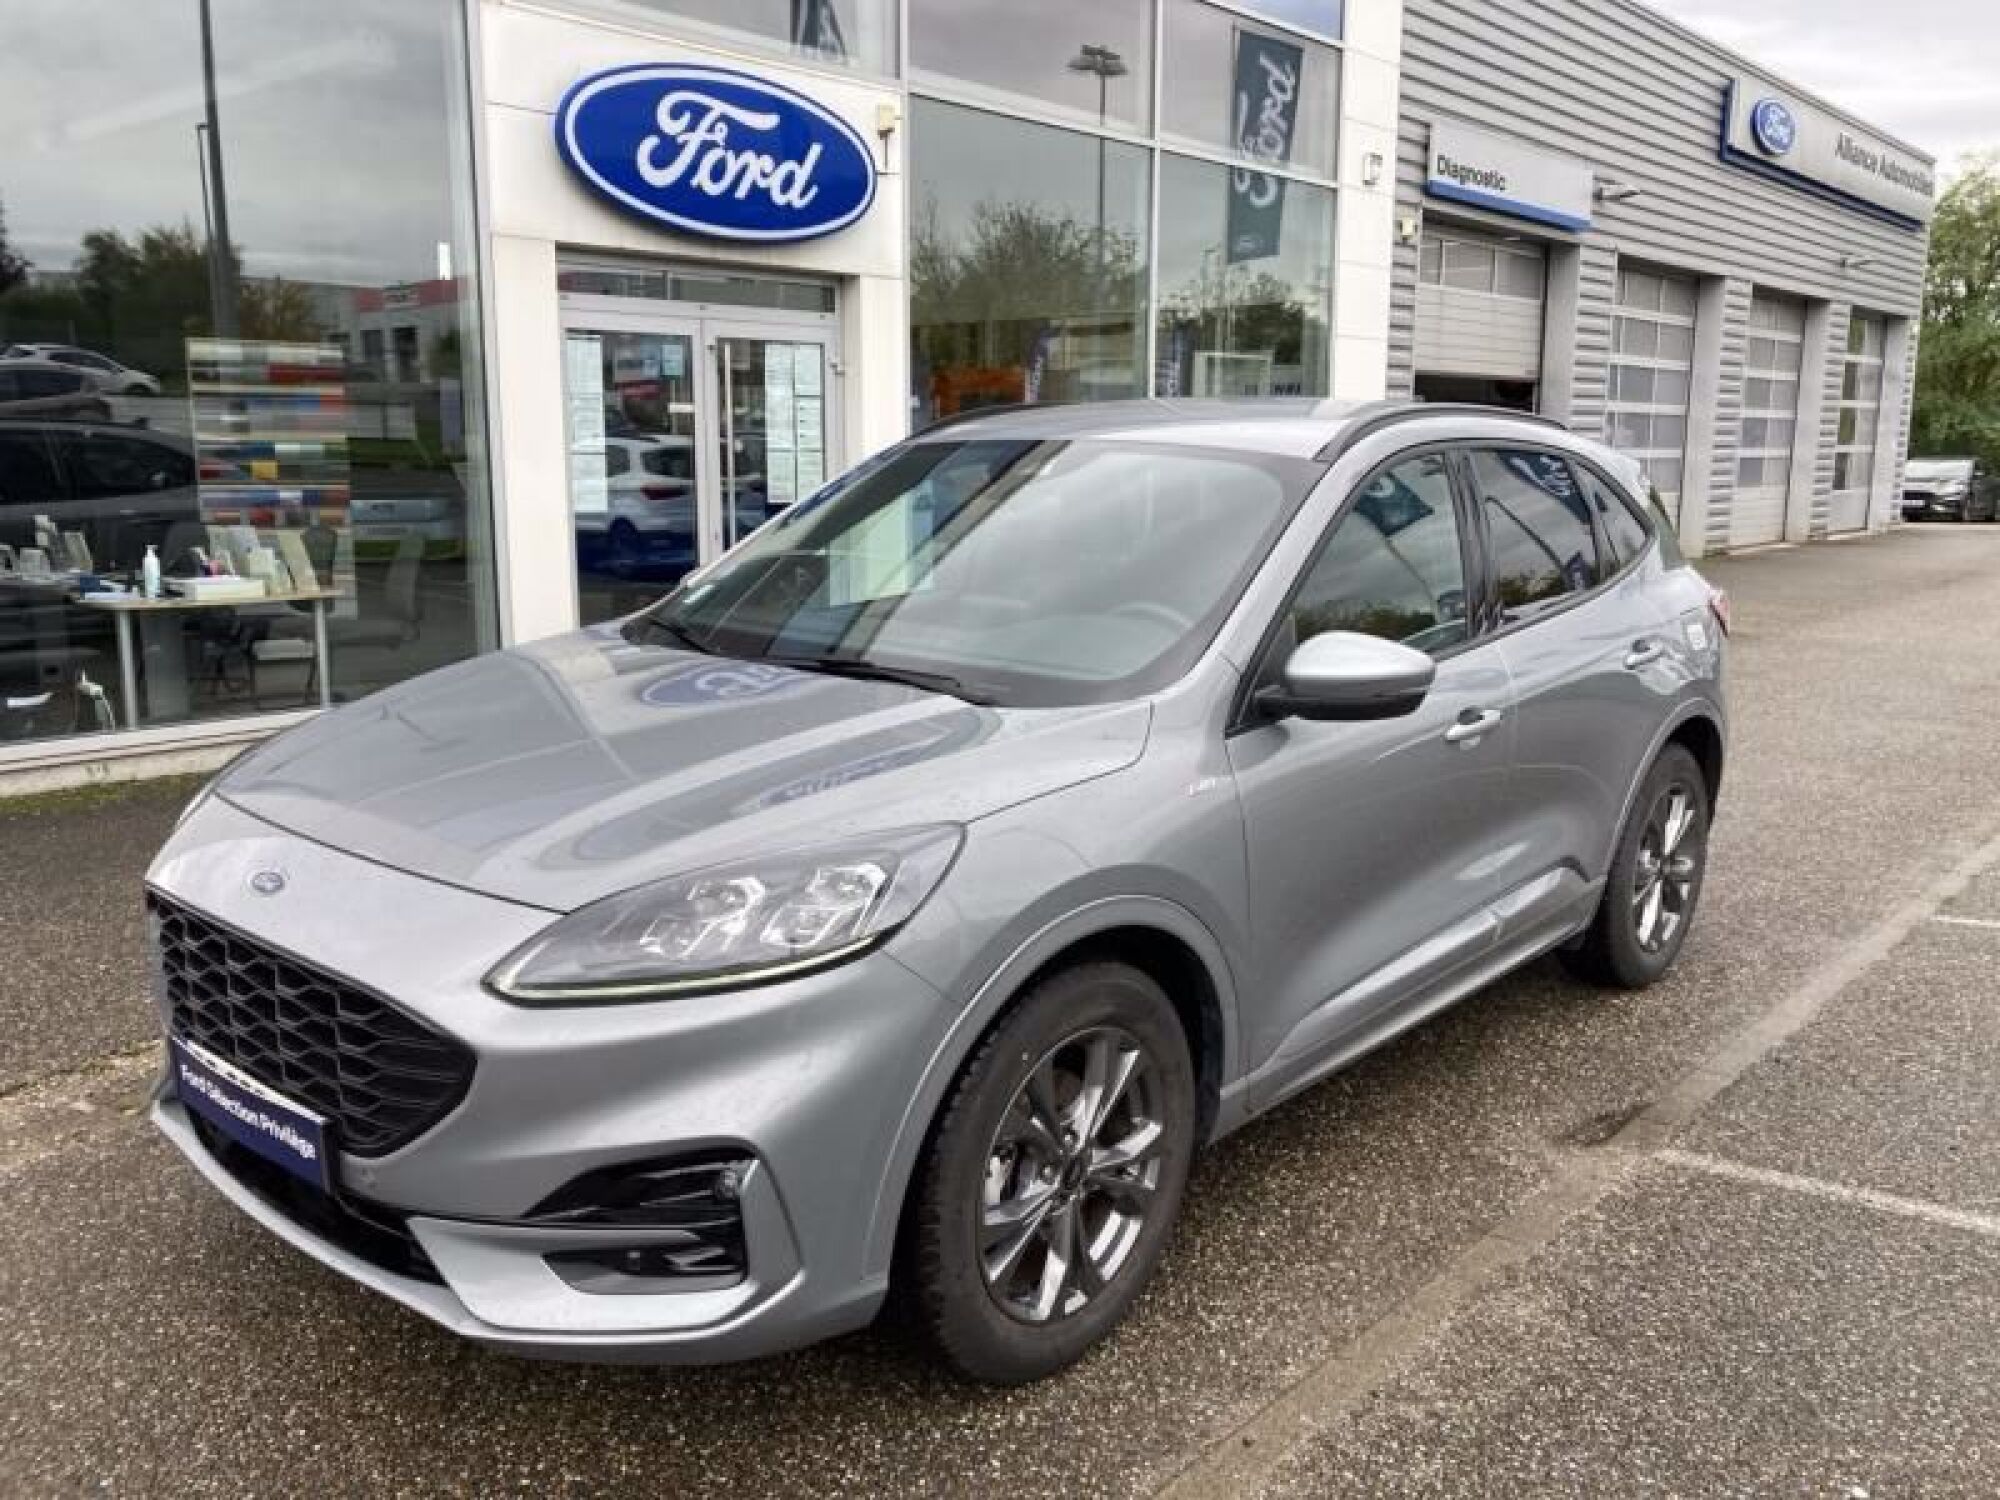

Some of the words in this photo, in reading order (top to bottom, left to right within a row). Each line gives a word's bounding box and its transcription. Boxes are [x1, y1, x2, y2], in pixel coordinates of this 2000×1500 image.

[637, 90, 823, 208] Ford
[1235, 50, 1296, 208] Ford
[1437, 154, 1506, 192] Diagnostic
